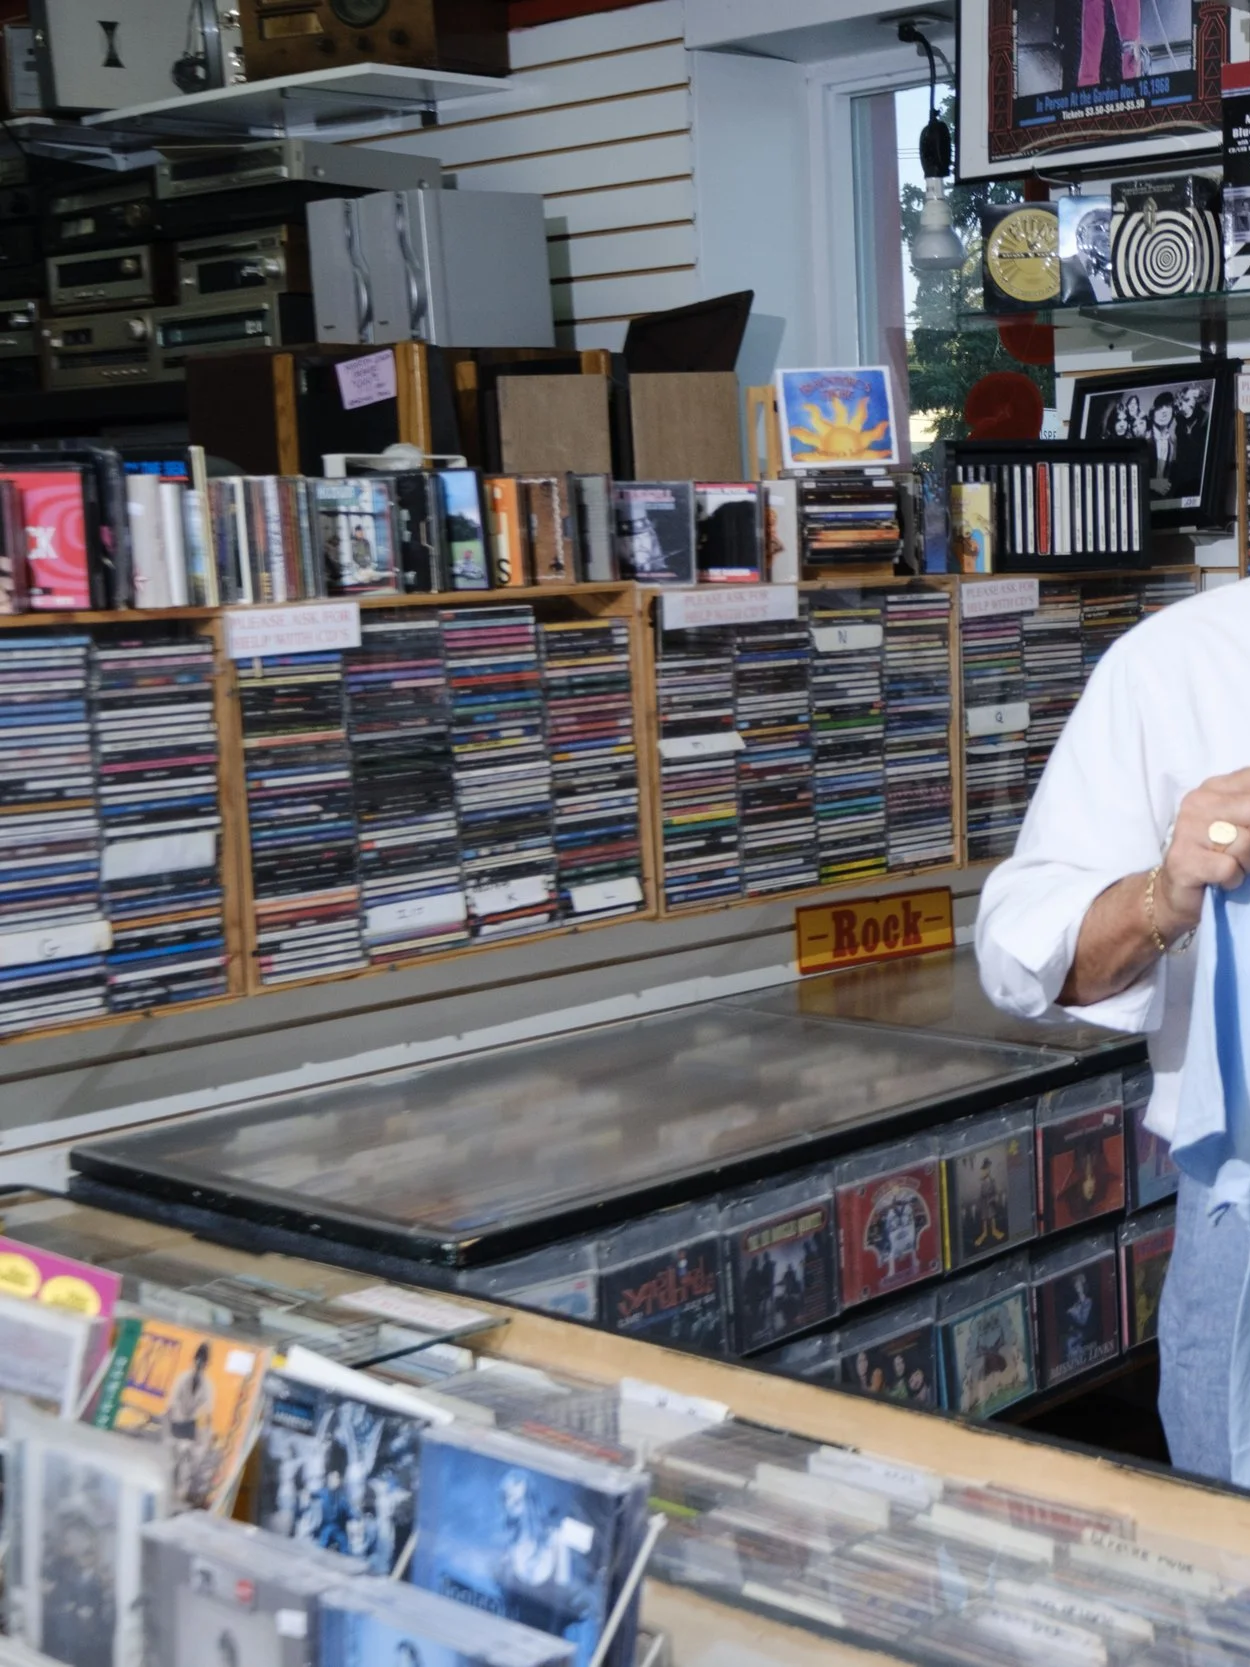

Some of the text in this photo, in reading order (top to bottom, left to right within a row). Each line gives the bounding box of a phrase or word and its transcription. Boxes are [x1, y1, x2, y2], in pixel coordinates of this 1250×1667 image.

[1045, 95, 1069, 111] Person
[1070, 92, 1079, 108] At
[1080, 90, 1091, 105] the
[1093, 87, 1119, 104] Garden
[1062, 109, 1085, 120] Tickets
[966, 581, 1035, 597] PLEASE ASK FOR
[683, 589, 768, 607] PLEASE ASK FOR
[966, 601, 990, 614] HELP
[991, 600, 1011, 611] WITH
[684, 609, 713, 624] HELP
[832, 900, 922, 958] Rock
